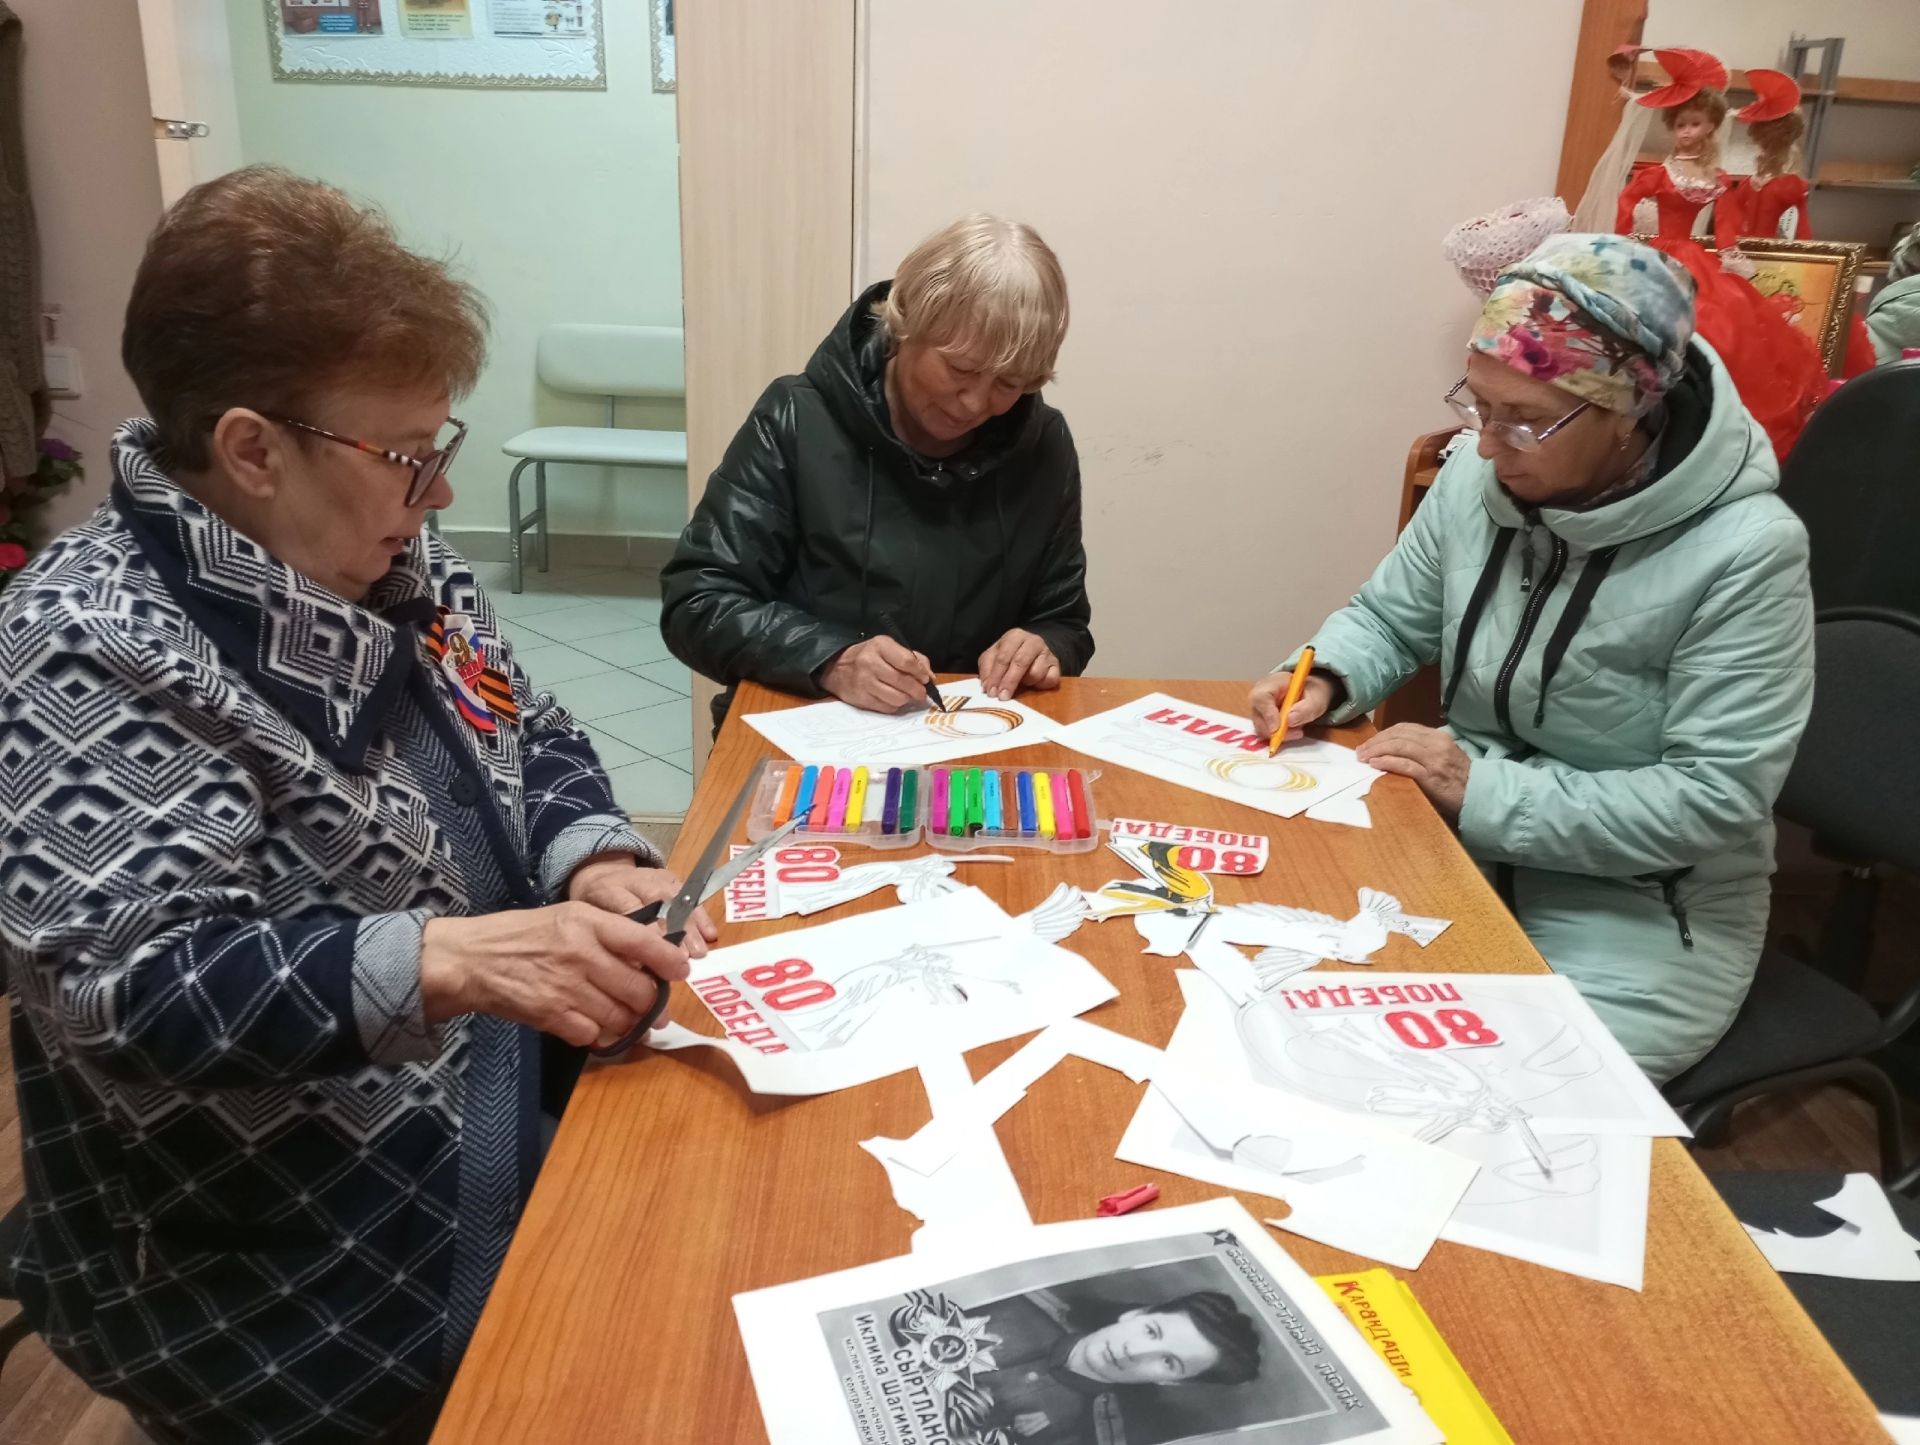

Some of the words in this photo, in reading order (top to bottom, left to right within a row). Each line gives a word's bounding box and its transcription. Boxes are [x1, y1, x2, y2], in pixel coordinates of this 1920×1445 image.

[1113, 821, 1261, 849] ПОБЕДА!
[775, 848, 839, 883] 80
[1177, 846, 1260, 874] 80
[728, 848, 766, 919] БЕДА!
[741, 958, 837, 1011] 80
[1280, 982, 1463, 1009] ПОБЕДА!
[1384, 1008, 1499, 1050] 80
[855, 1313, 889, 1377] Иклима
[1226, 1249, 1323, 1356] БЕССМЕРТНЫЙ
[1314, 1361, 1364, 1411] ПОЛК
